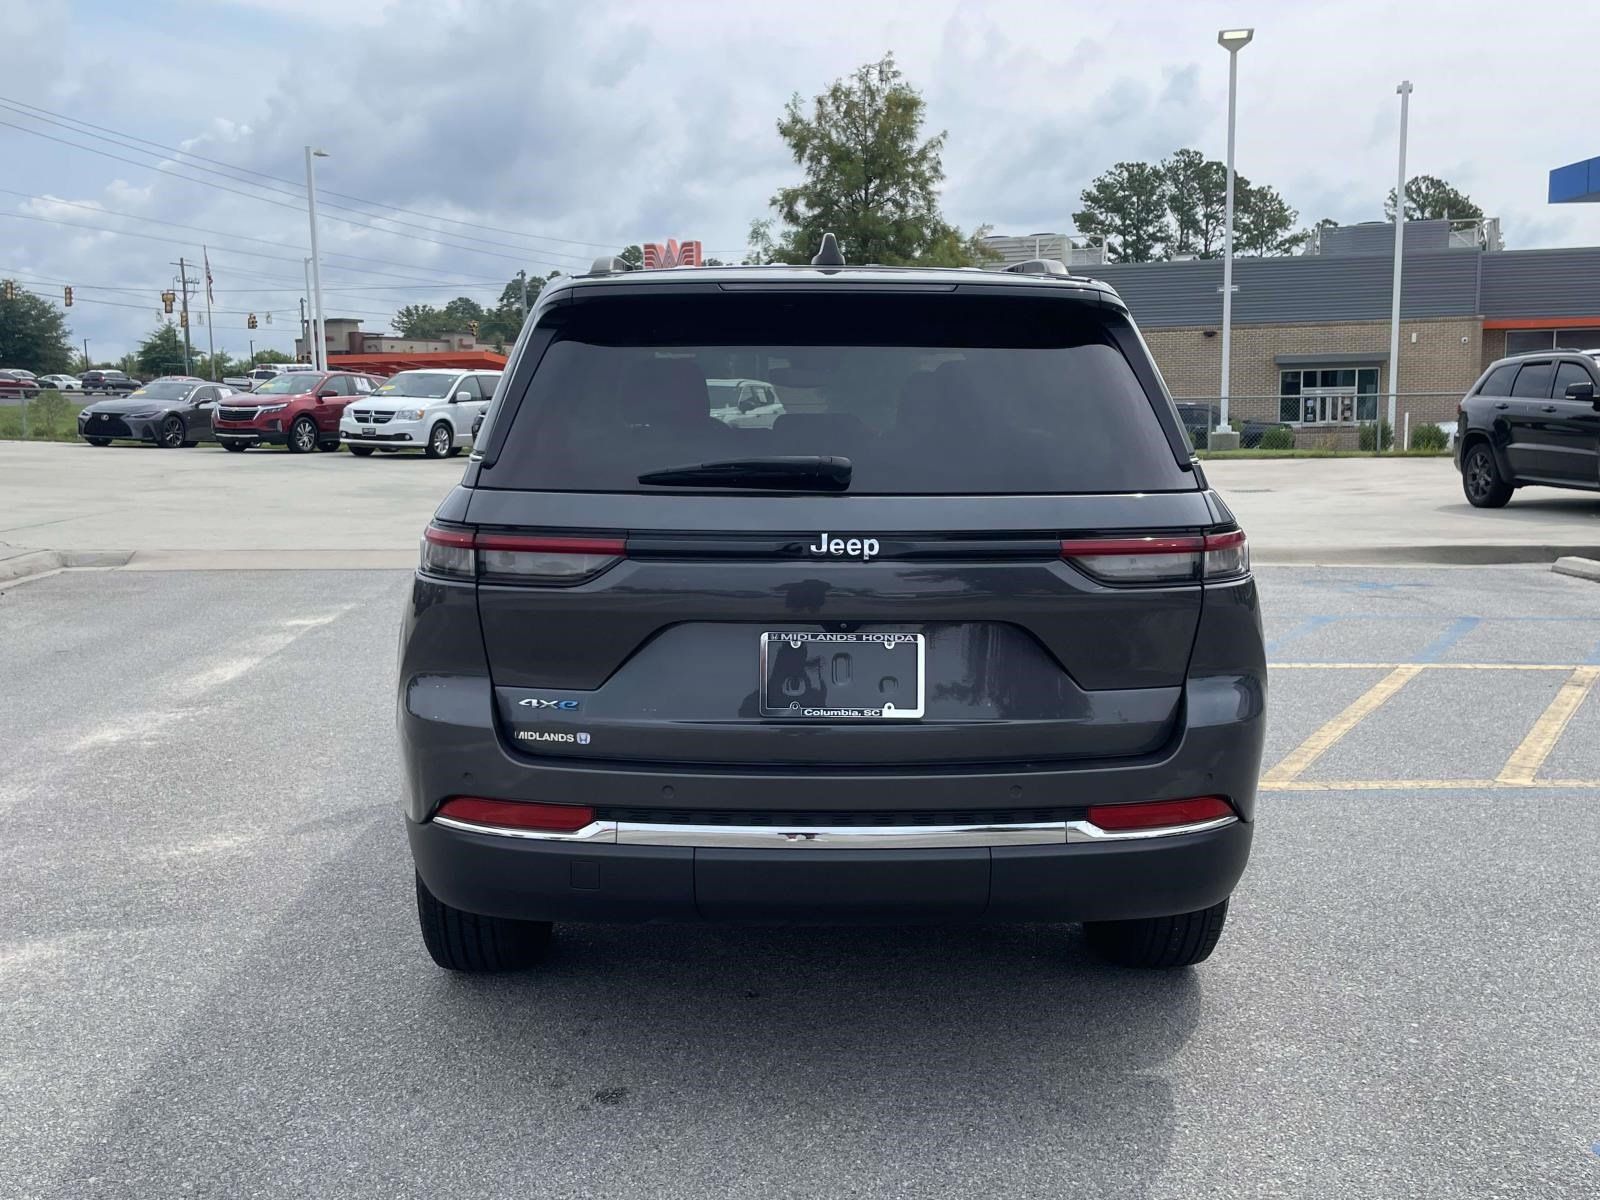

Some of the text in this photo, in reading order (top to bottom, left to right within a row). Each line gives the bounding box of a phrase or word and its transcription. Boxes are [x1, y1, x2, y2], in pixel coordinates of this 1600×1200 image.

[810, 533, 880, 560] Jeep
[781, 633, 915, 642] MIDLANDS HONDA
